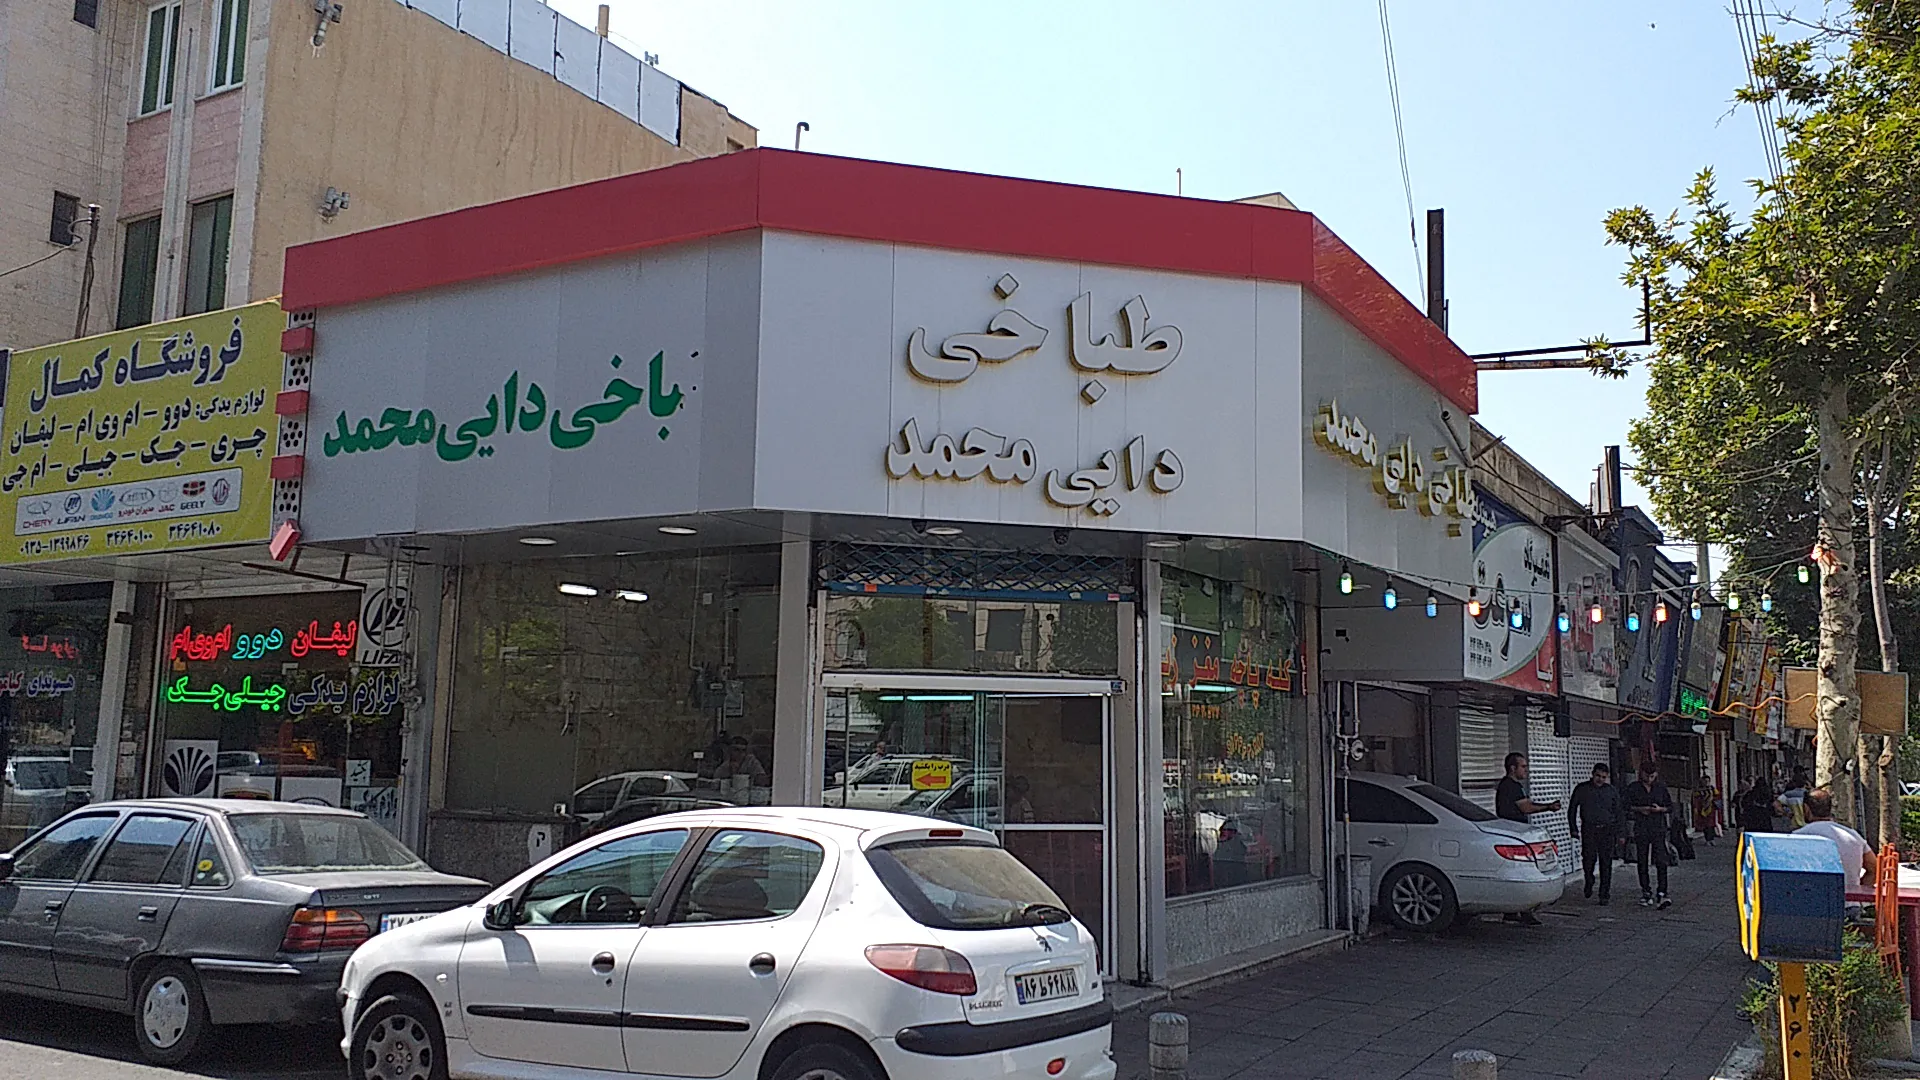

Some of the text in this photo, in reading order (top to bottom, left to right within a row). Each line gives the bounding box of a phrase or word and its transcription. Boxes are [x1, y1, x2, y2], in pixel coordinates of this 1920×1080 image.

[906, 272, 1183, 404] طباخی
[30, 315, 243, 413] فروشگاه کمال
[161, 397, 191, 431] دوو
[234, 389, 265, 416] لوازم
[436, 370, 546, 461] دایی
[10, 415, 56, 455] لیفان
[211, 426, 267, 464] چری
[323, 408, 436, 457] محمد
[1314, 397, 1378, 467] محمد
[66, 446, 118, 483] جیلی
[140, 435, 186, 468] جک
[885, 416, 1184, 516] دایی محمد
[23, 518, 53, 529] CHERY
[56, 514, 86, 525] LIFAN
[158, 504, 175, 513] JAC
[180, 500, 206, 511] GEELY
[232, 628, 284, 660] دوو
[290, 619, 358, 657] لیفان
[361, 649, 404, 665] LIFA
[167, 674, 224, 710] جک
[224, 675, 287, 714] جیلی
[288, 671, 348, 715] یدکی
